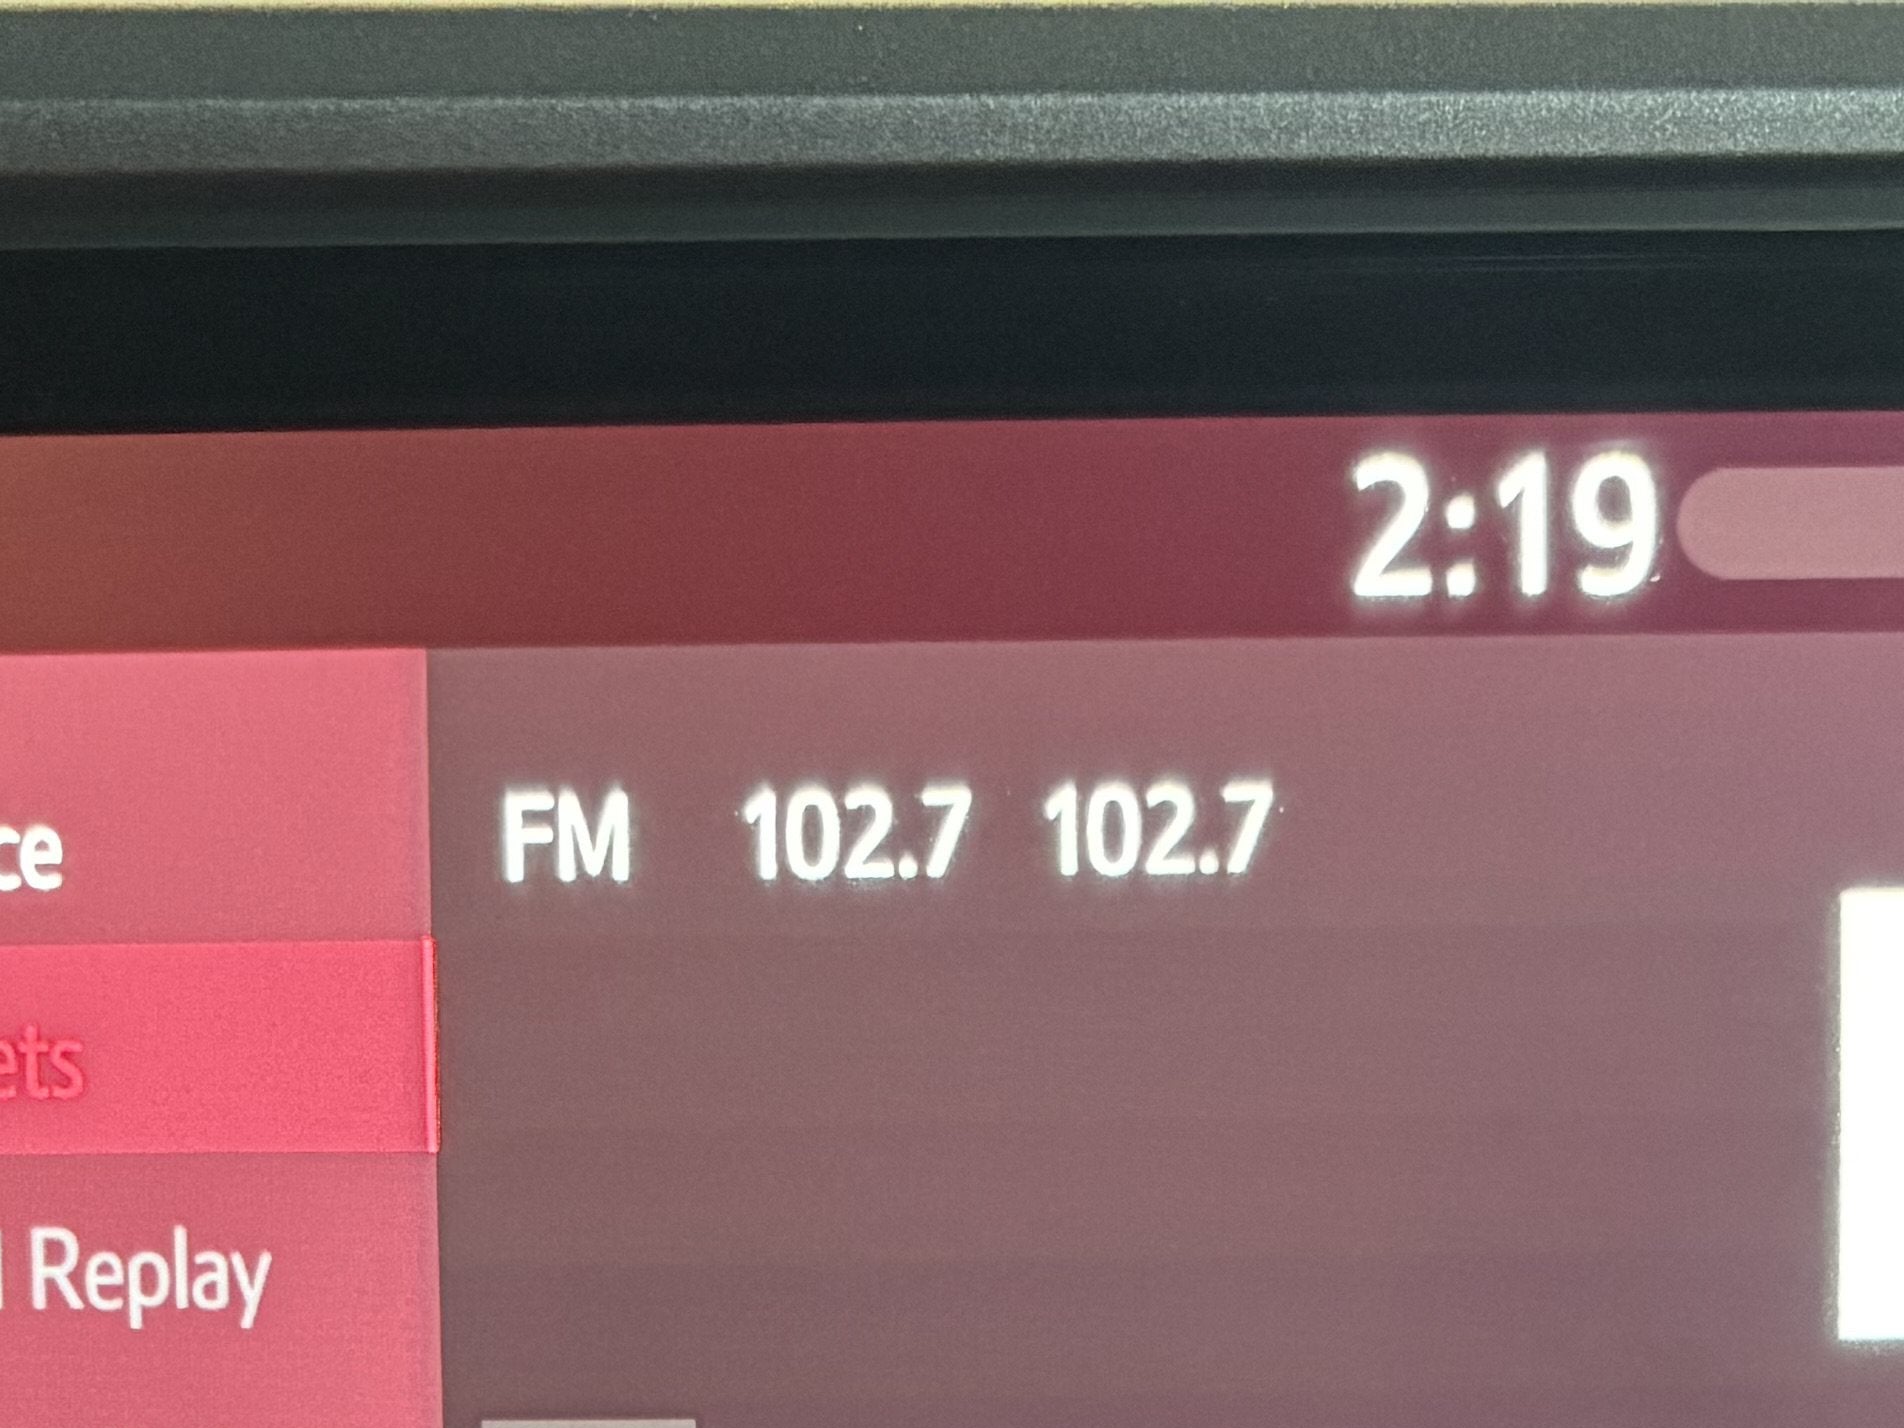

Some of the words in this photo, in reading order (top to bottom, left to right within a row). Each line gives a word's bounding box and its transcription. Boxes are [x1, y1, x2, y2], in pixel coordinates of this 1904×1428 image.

[1351, 449, 1659, 599] 2:19
[502, 786, 631, 884] FM
[744, 783, 973, 881] 102.7
[1045, 781, 1275, 877] 102.7
[31, 1226, 272, 1329] Replay
